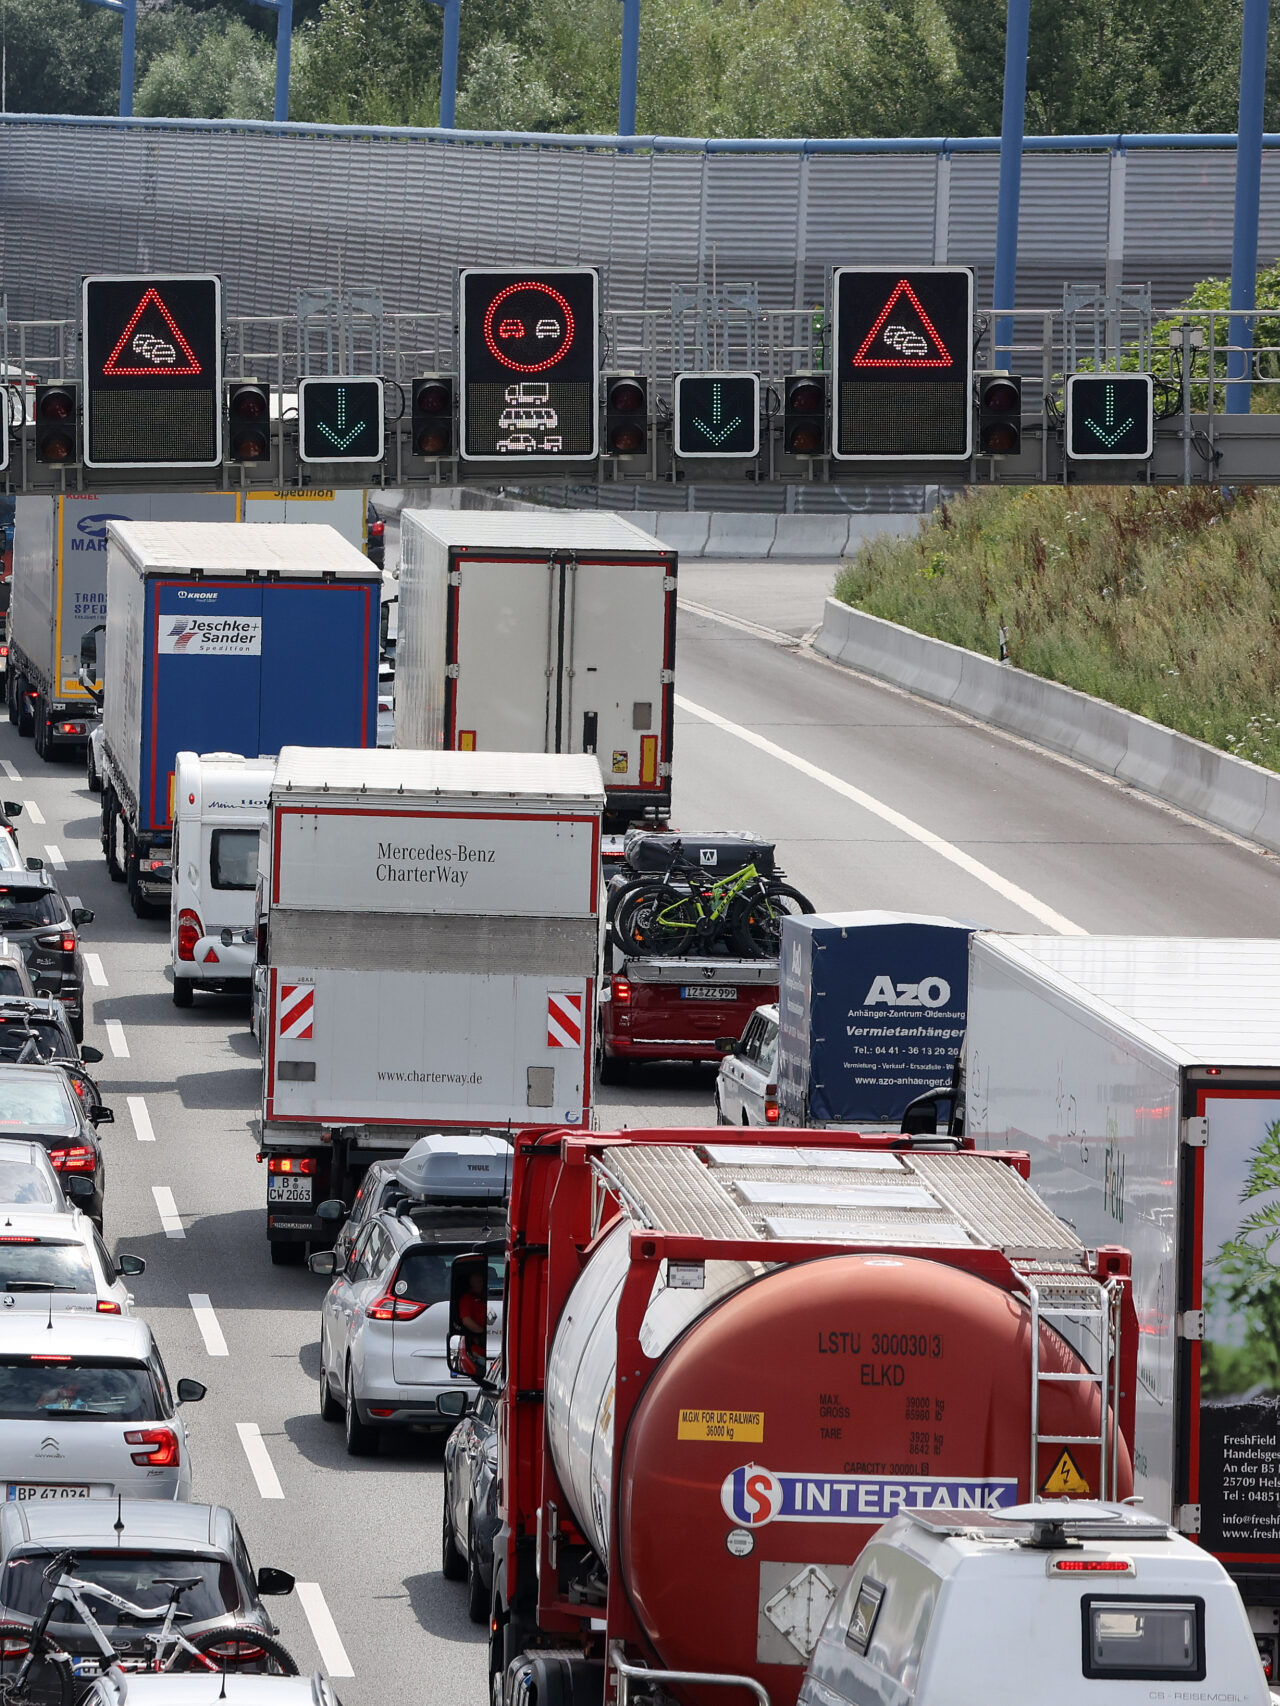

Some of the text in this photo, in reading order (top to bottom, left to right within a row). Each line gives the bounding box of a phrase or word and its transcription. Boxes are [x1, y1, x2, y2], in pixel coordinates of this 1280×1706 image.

[189, 620, 260, 632] Jeschke+
[201, 632, 256, 643] Sander
[377, 842, 496, 863] Mercedes-Benz
[376, 864, 468, 887] CharterWay
[704, 987, 717, 997] ZZ
[719, 988, 736, 998] 999
[863, 975, 951, 1008] AzO
[847, 1010, 966, 1019] Anhänger-Zentrum-Oldenburg
[846, 1026, 967, 1039] Vermietanhänger
[853, 1046, 872, 1054] Tel.:
[875, 1046, 886, 1054] 04
[888, 1046, 899, 1054] 41
[921, 1047, 932, 1055] 13
[934, 1047, 945, 1055] 20
[843, 1062, 877, 1070] Vermietung
[377, 1070, 483, 1086] www.charterway.de
[467, 1164, 490, 1172] THULE
[282, 1178, 289, 1188] B
[269, 1189, 311, 1201] CW 2063
[819, 1331, 861, 1354] LSTU
[861, 1364, 905, 1386] ELKD
[935, 1398, 944, 1412] kg
[701, 1412, 715, 1424] FOR
[716, 1412, 727, 1424] UIC
[729, 1412, 760, 1425] RAILWAYS
[820, 1407, 850, 1418] GROSS
[935, 1410, 942, 1421] lb
[706, 1425, 734, 1439] 36000 kg
[820, 1428, 944, 1446] TARE 3920 kg
[1223, 1435, 1276, 1446] FreshField
[933, 1445, 941, 1455] lb
[844, 1462, 886, 1474] CAPACITY
[1223, 1463, 1275, 1473] An der B5
[1223, 1477, 1256, 1487] 25709
[19, 1488, 36, 1500] BP
[41, 1489, 57, 1500] 47
[794, 1482, 1005, 1512] INTERTANK
[1223, 1491, 1239, 1501] Tel
[1248, 1491, 1280, 1501] 04851
